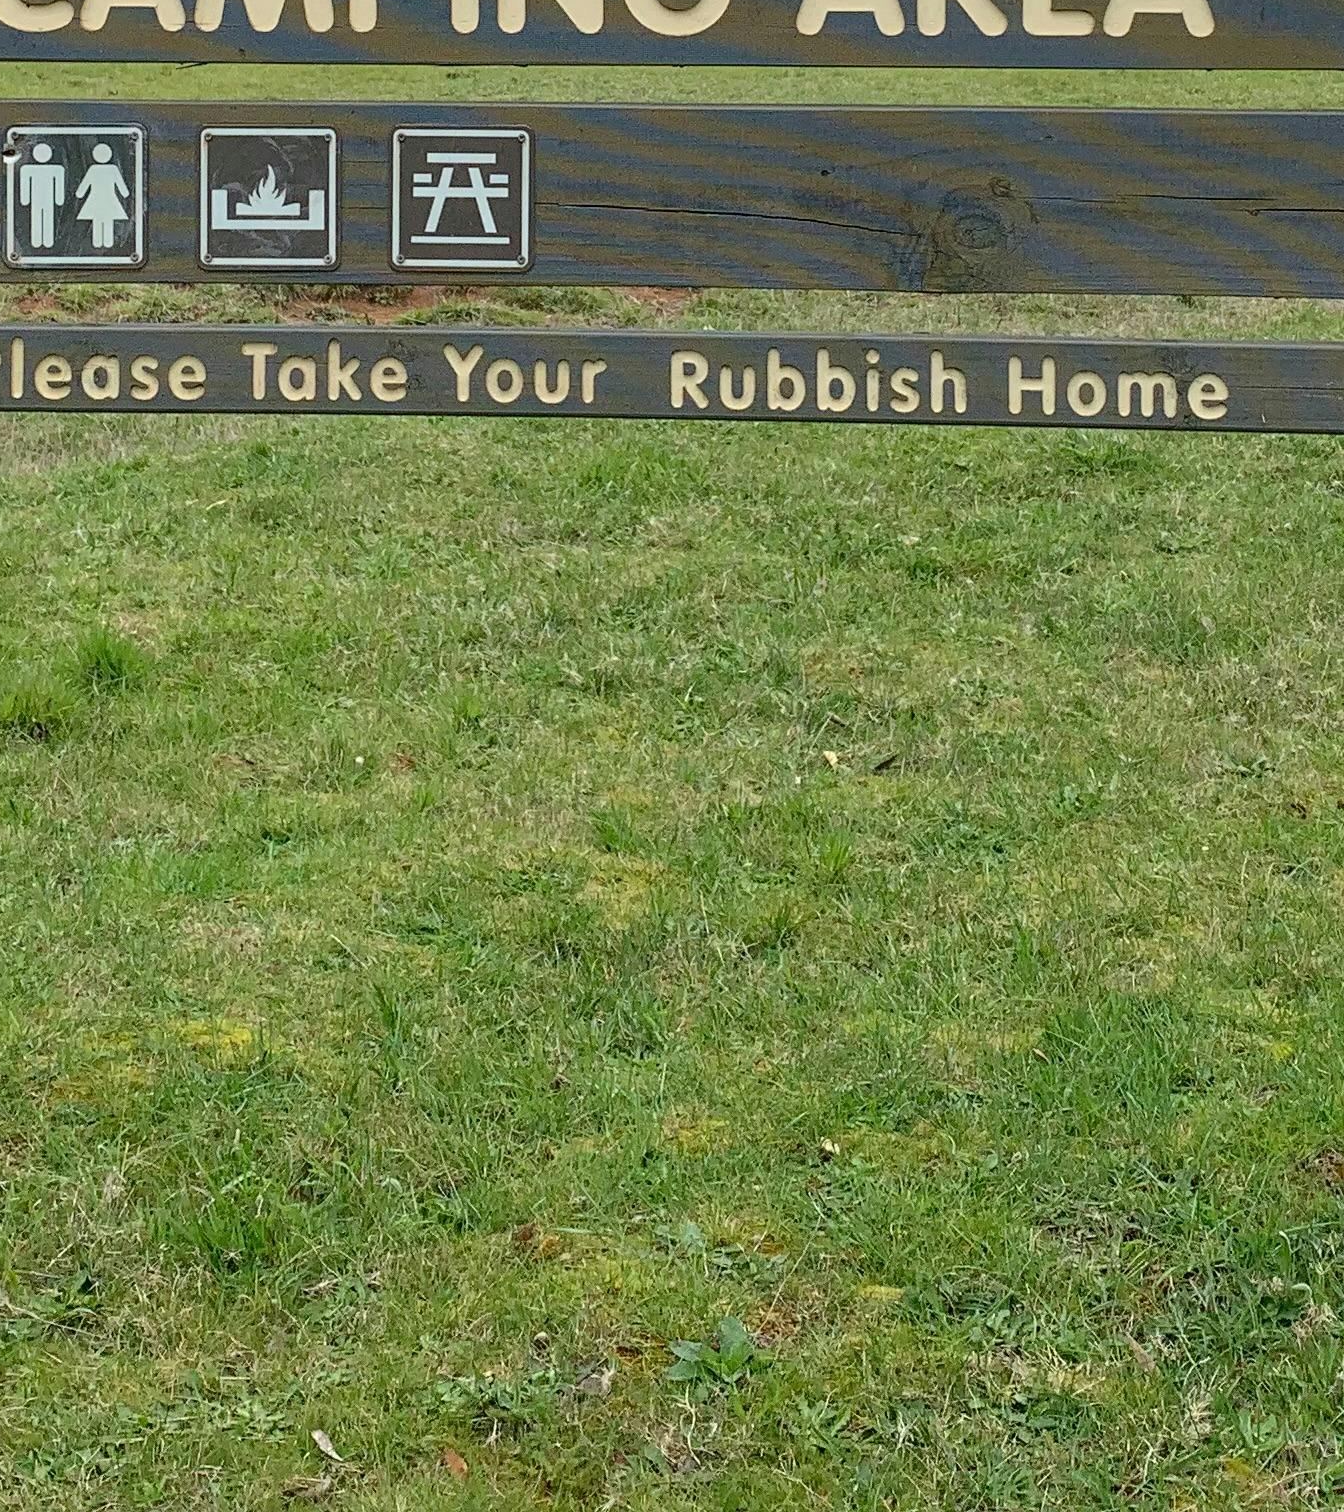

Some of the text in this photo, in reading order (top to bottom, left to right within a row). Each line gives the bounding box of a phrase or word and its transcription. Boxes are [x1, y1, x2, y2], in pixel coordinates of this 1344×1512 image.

[240, 343, 409, 403] Take
[442, 346, 609, 405] Your
[669, 348, 968, 415] Rubbish
[1007, 356, 1230, 421] Home
